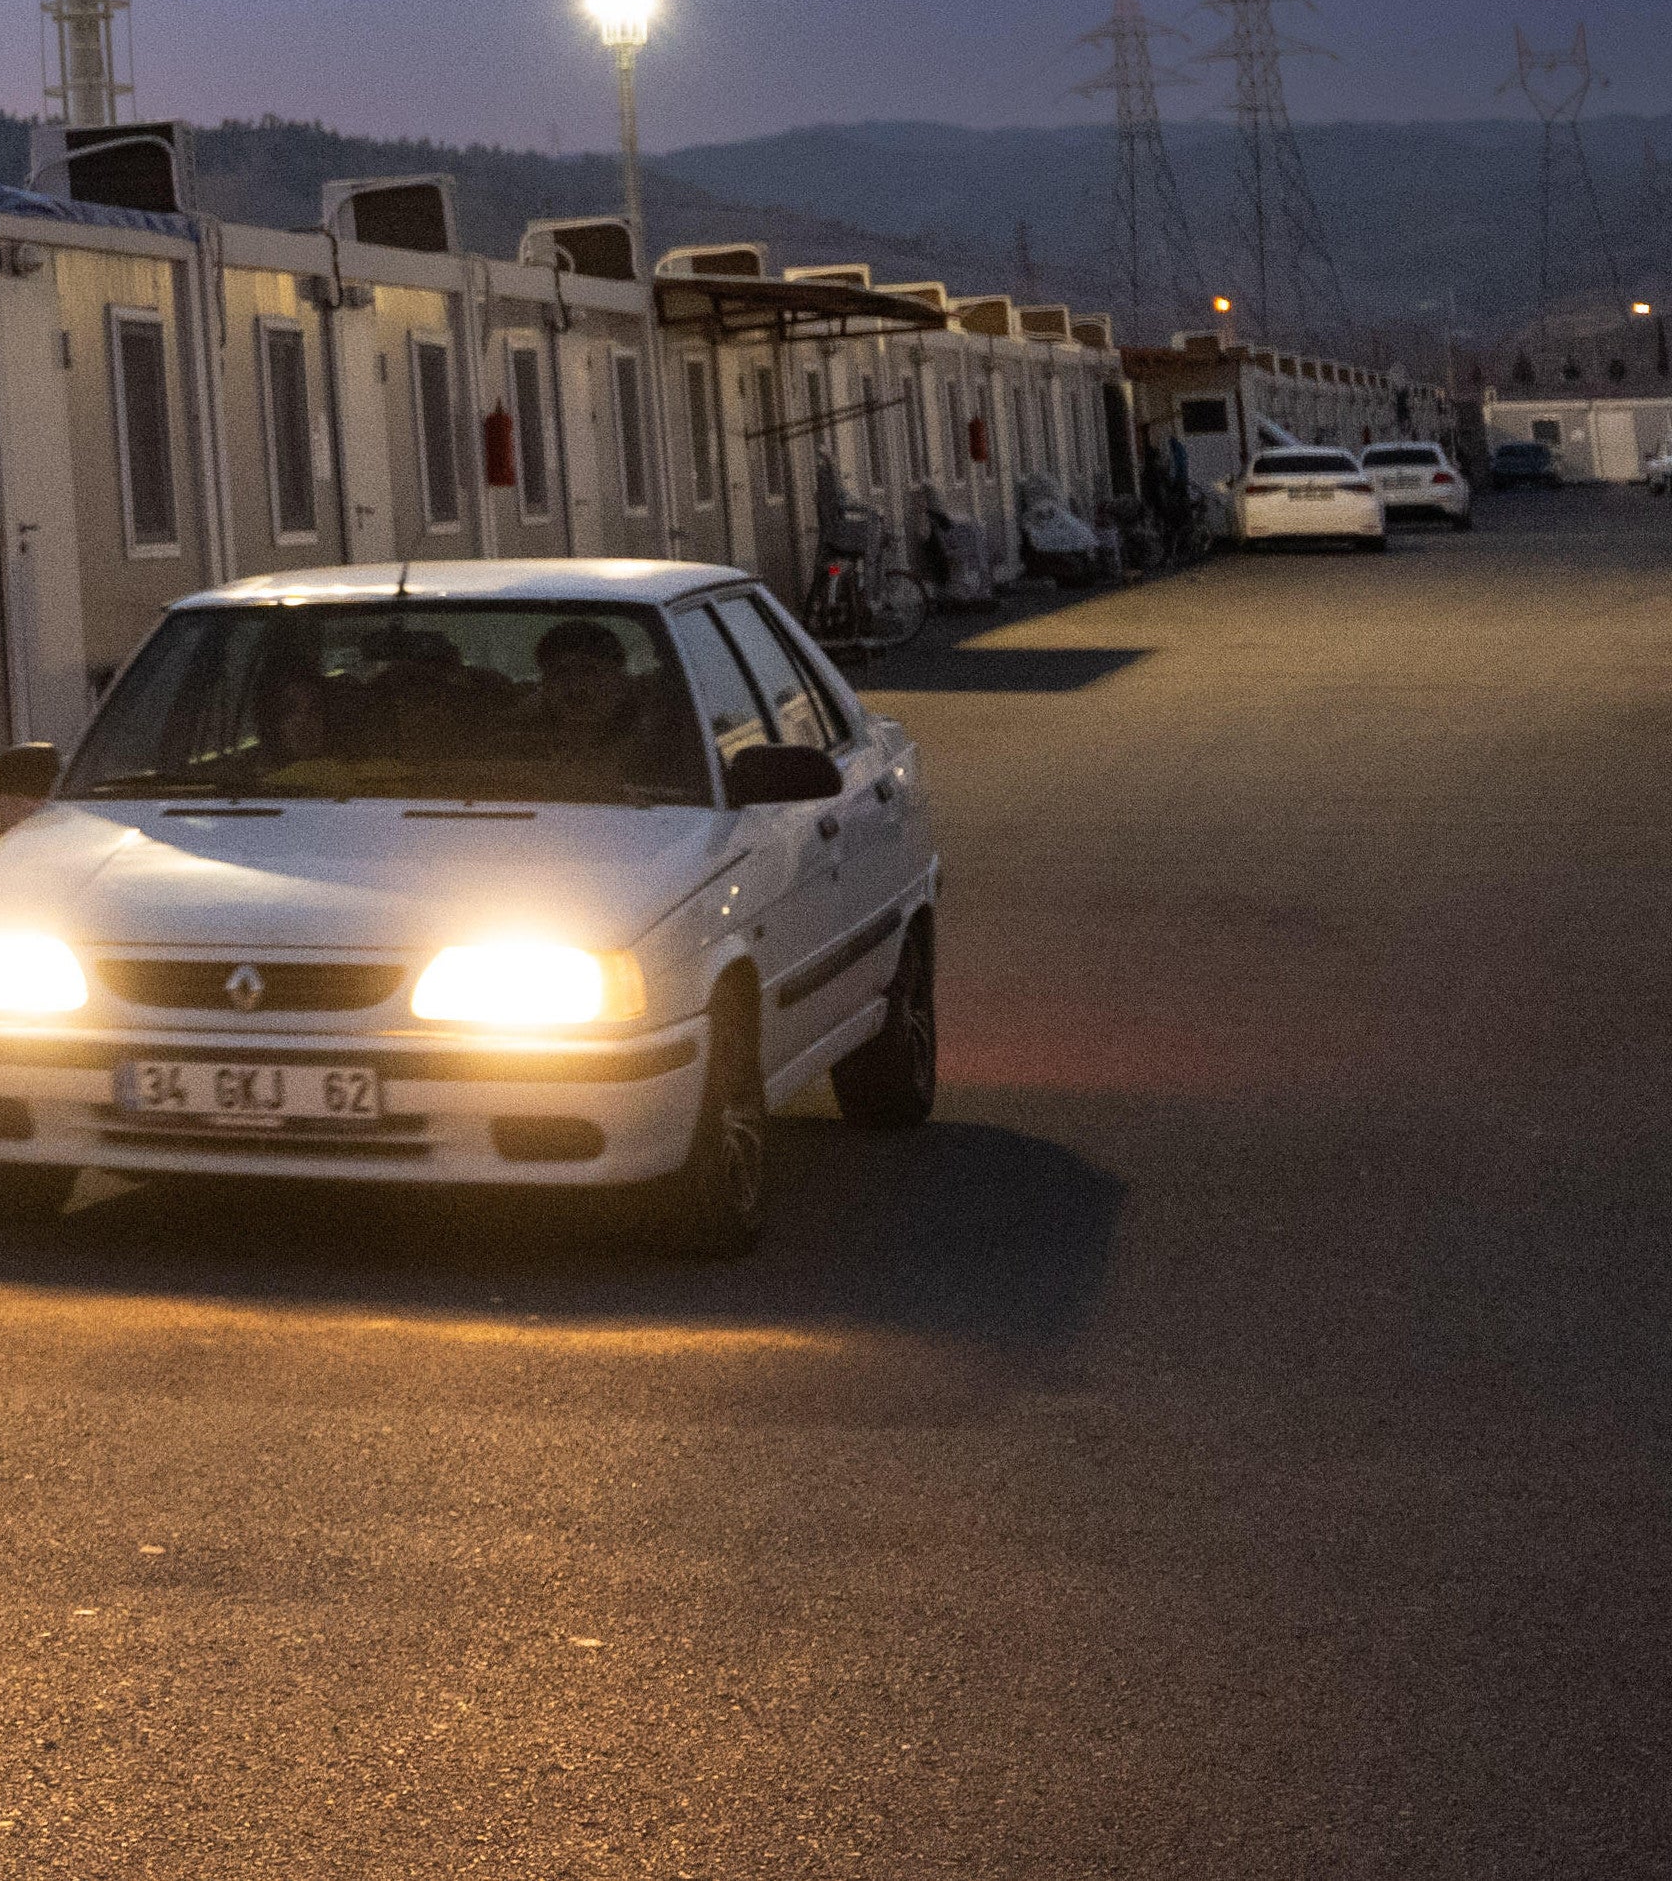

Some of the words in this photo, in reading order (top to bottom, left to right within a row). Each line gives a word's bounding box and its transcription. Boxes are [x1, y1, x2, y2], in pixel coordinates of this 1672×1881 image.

[144, 1066, 187, 1108] 34
[214, 1067, 286, 1111] GKJ
[324, 1071, 372, 1114] 62
